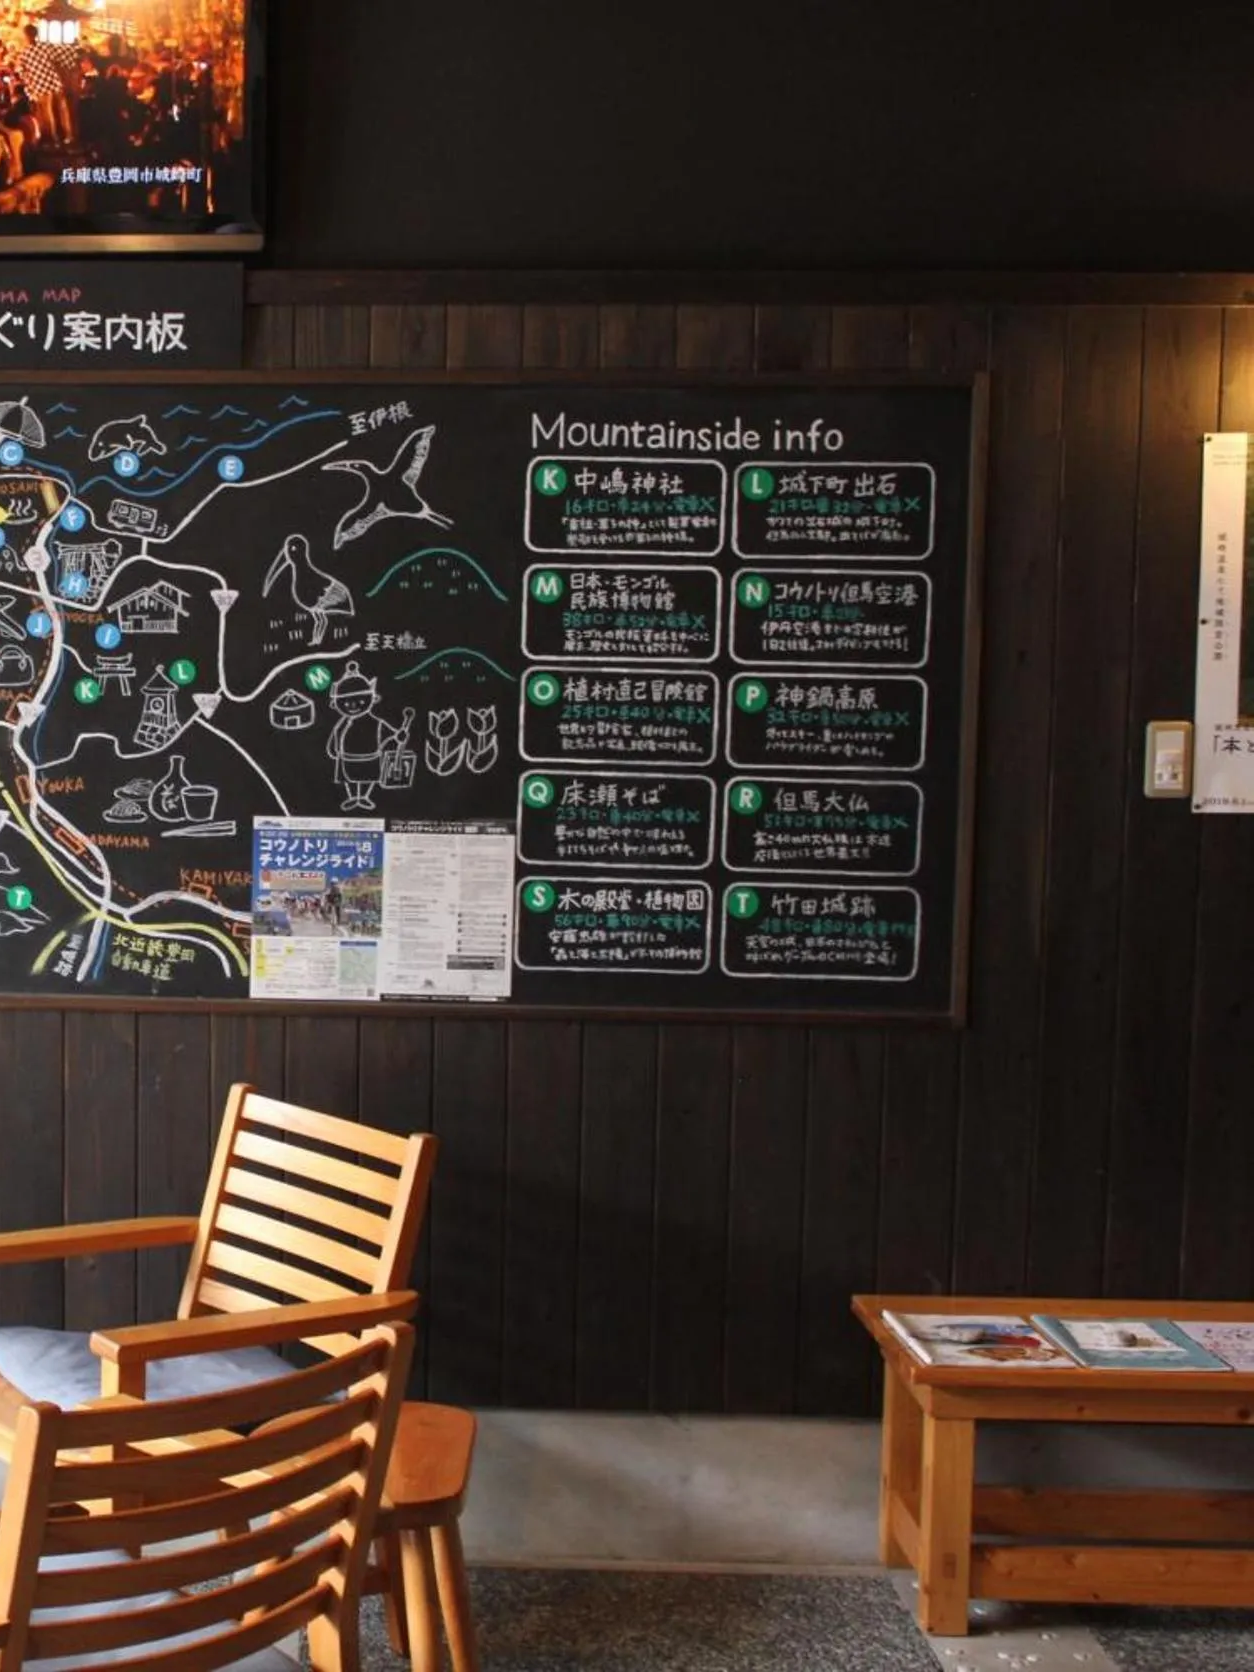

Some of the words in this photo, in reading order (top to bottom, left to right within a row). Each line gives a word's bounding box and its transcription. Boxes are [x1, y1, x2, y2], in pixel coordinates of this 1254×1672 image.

[42, 287, 83, 304] MAP
[348, 401, 415, 436] 至伊根
[531, 411, 762, 451] Mountainside
[773, 418, 844, 453] info
[574, 466, 684, 496] 中嶋神社
[570, 571, 671, 590] 日本・モンゴル
[570, 589, 676, 612] 民族博物館
[774, 581, 920, 607] コウノトリ但馬空港
[562, 677, 709, 702] 植村直己冒険館
[773, 682, 880, 711] 神鍋高原
[561, 779, 667, 807] 床瀬そば
[773, 788, 871, 814] 但馬大仏
[259, 838, 328, 853] コウノトリ
[259, 852, 368, 869] チャレンジライド
[771, 893, 878, 919] 竹田城跡
